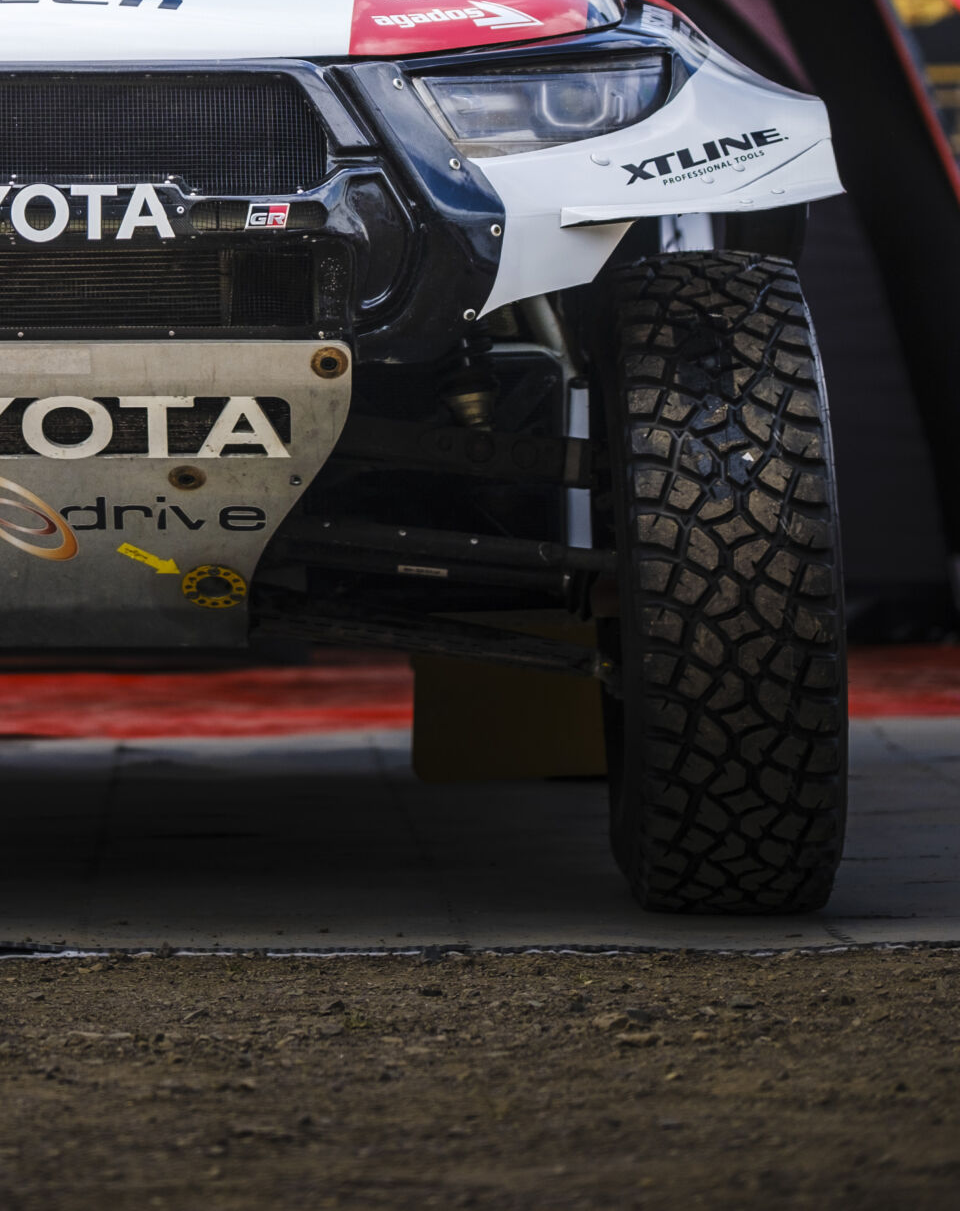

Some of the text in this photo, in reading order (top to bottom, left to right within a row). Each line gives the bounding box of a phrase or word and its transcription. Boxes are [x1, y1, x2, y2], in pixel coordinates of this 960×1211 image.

[371, 8, 485, 28] agados
[621, 127, 782, 185] XTLINE
[662, 149, 766, 186] PROFESSIONAL TOOLS
[250, 212, 286, 225] GR
[60, 496, 267, 533] drive
